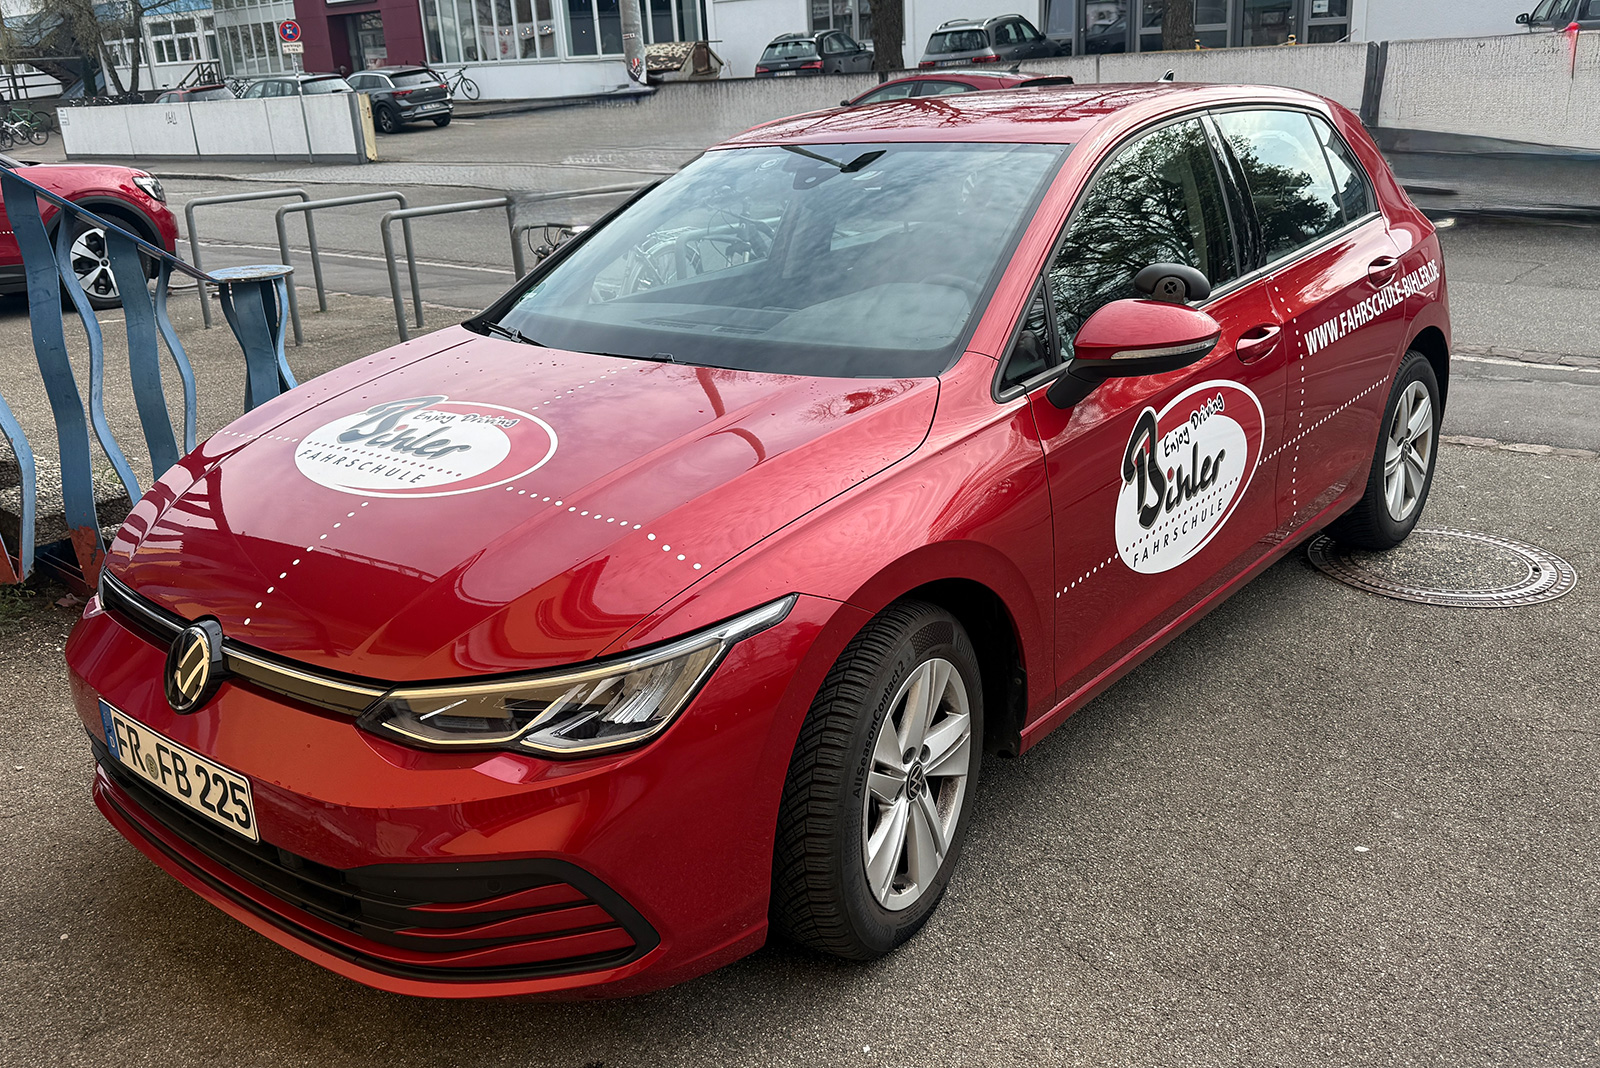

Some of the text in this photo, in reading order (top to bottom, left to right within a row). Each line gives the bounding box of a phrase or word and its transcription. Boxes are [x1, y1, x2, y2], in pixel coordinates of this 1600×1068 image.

[1304, 259, 1440, 356] WWW.FAHRSCHULE-BIHLER.DE
[337, 395, 472, 459] Bihler
[412, 411, 519, 428] Enjoy Driving
[1163, 394, 1224, 458] Enjoy Driving
[298, 449, 426, 484] FAHRSCHULE
[1122, 408, 1226, 530] Bihler
[1133, 497, 1224, 568] FAHRSCHULE
[852, 660, 906, 799] AllSeasonContact 2
[113, 716, 147, 773] FR
[156, 742, 192, 798] FB
[195, 764, 252, 830] 225
